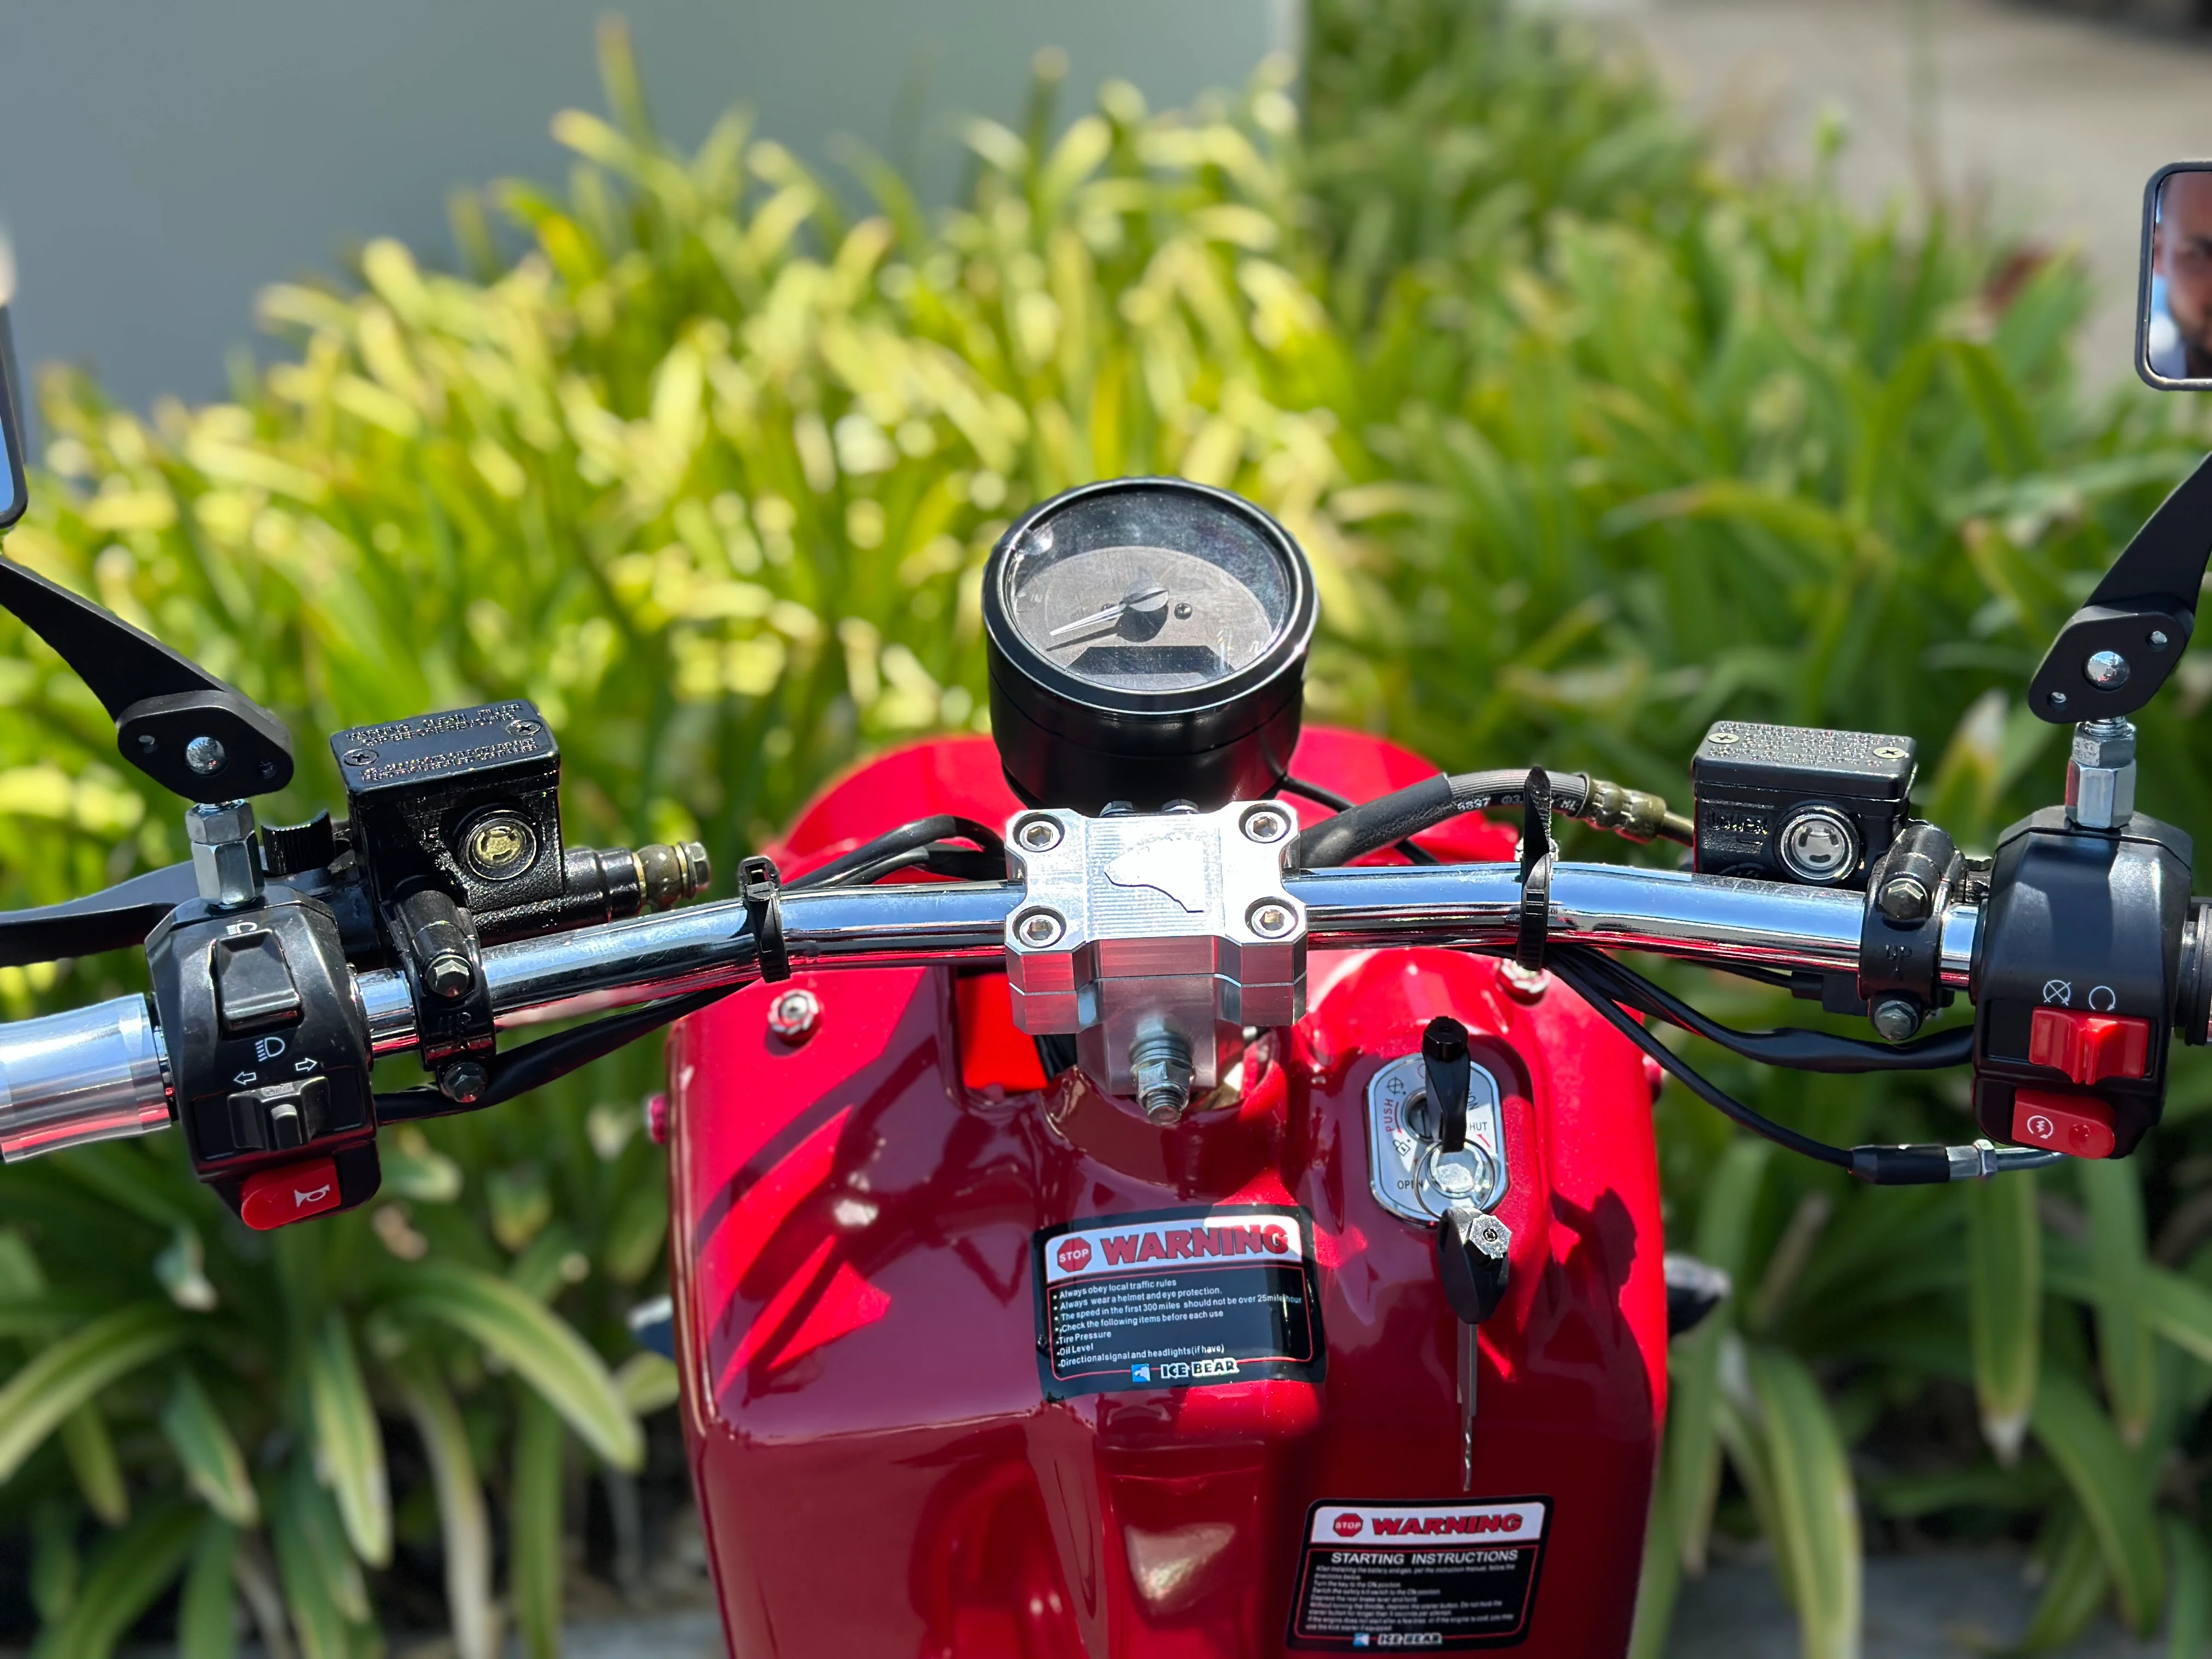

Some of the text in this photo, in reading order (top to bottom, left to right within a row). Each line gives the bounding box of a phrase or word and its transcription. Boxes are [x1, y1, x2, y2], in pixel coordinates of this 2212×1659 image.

[1383, 1098, 1394, 1133] PUSH
[1466, 1121, 1487, 1131] HUT
[1059, 1223, 1288, 1266] STOP WARNING
[1060, 1288, 1086, 1299] Always
[1109, 1283, 1128, 1291] local
[1130, 1281, 1155, 1289] traffic
[1060, 1299, 1088, 1310] Always
[1146, 1291, 1161, 1300] and
[1178, 1288, 1222, 1298] protection.
[1061, 1313, 1075, 1321] The
[1076, 1308, 1100, 1318] speed
[1125, 1305, 1142, 1313] first
[1159, 1302, 1180, 1310] miles
[1184, 1299, 1211, 1308] should
[1062, 1323, 1085, 1333] Check
[1101, 1317, 1138, 1325] following
[1163, 1313, 1187, 1322] before
[1189, 1311, 1207, 1319] each
[1075, 1331, 1111, 1341] Pressure
[1060, 1343, 1093, 1356] Oil Level
[1131, 1350, 1146, 1358] and
[1161, 1357, 1239, 1379] ICE BEAR
[1335, 1513, 1523, 1535] STOP WARNING
[1331, 1549, 1518, 1565] STARTING INSTRUCTIONS
